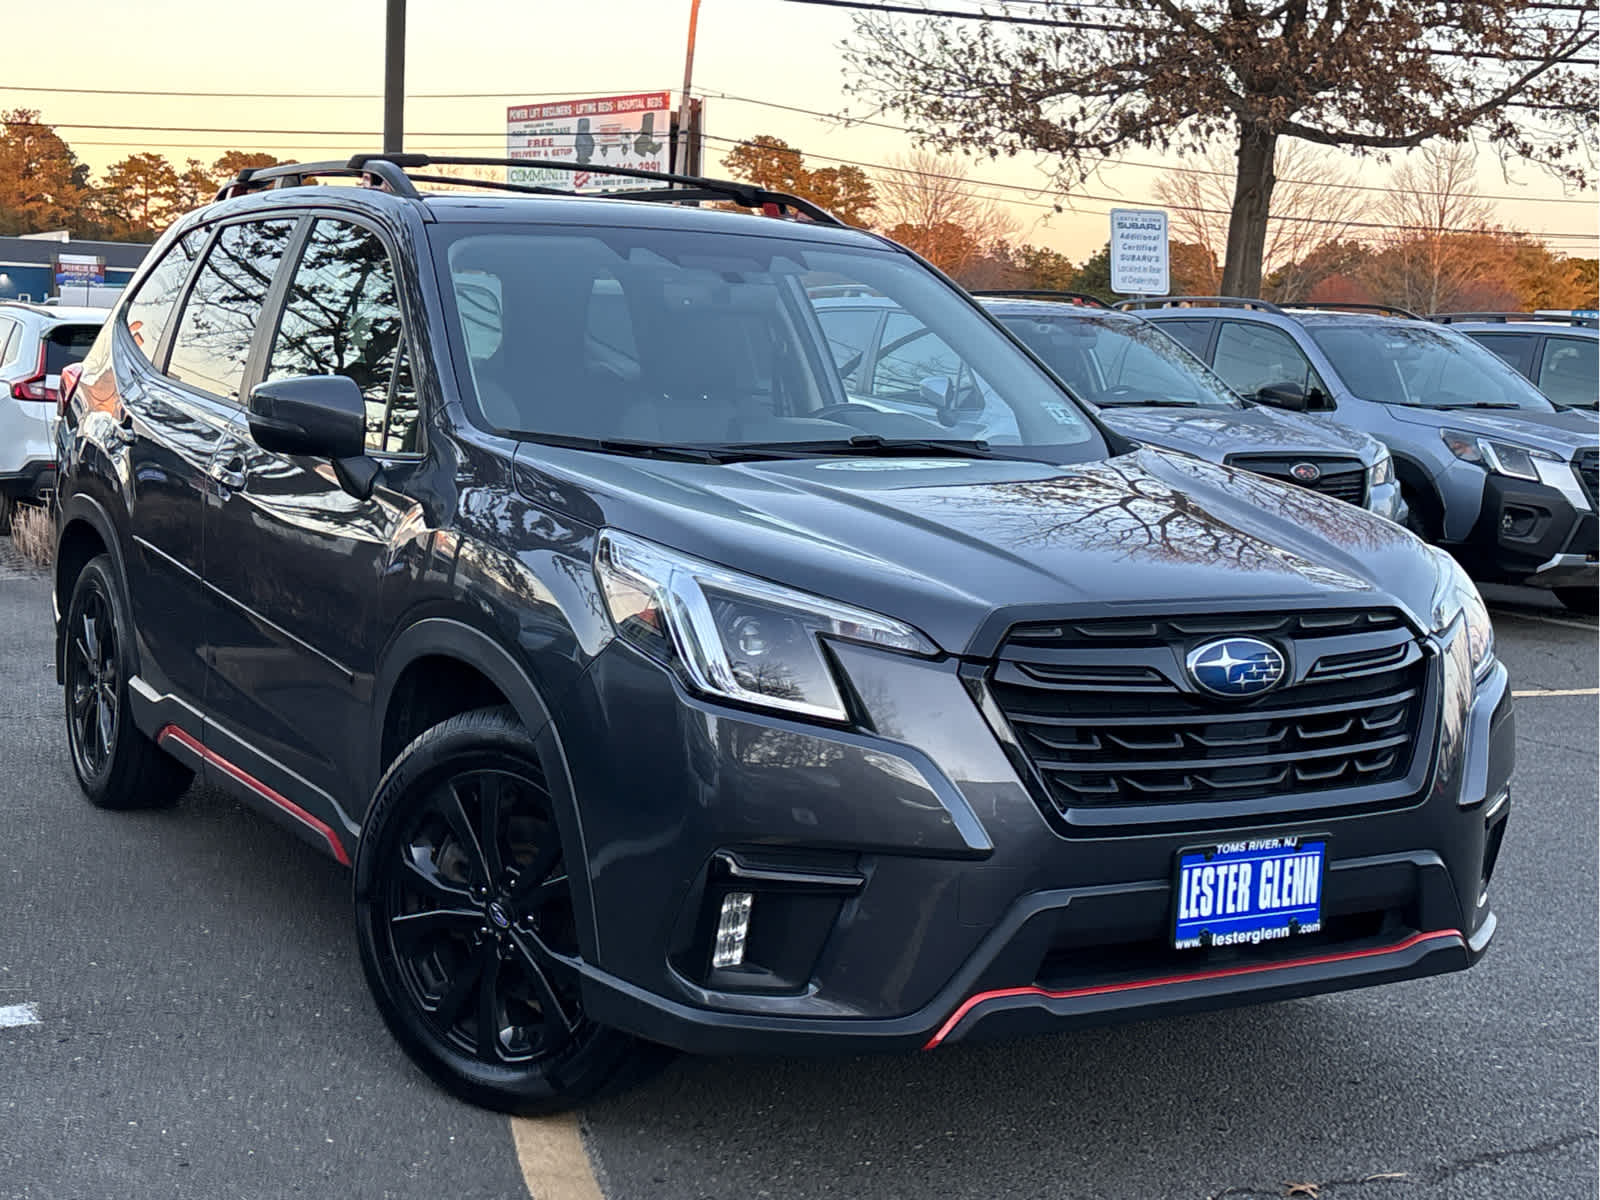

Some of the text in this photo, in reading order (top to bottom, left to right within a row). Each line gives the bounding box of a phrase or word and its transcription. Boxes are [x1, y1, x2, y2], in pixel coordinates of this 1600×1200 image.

[509, 96, 663, 120] POWER LIFT RECLINERS LIFTING BEDS HOSPITAL BEDS
[527, 137, 554, 147] FREE
[510, 149, 541, 158] DELIVERY
[551, 147, 573, 156] SETUP
[1117, 222, 1162, 231] SUBARU
[1119, 232, 1160, 241] Additional
[1122, 243, 1158, 252] Certified
[1120, 254, 1160, 263] SUBARU'S
[1216, 843, 1248, 855] TOMS
[1284, 837, 1298, 848] NJ
[1179, 856, 1320, 920] LESTER GLENN
[1175, 922, 1321, 950] www. lesterglenn .com
